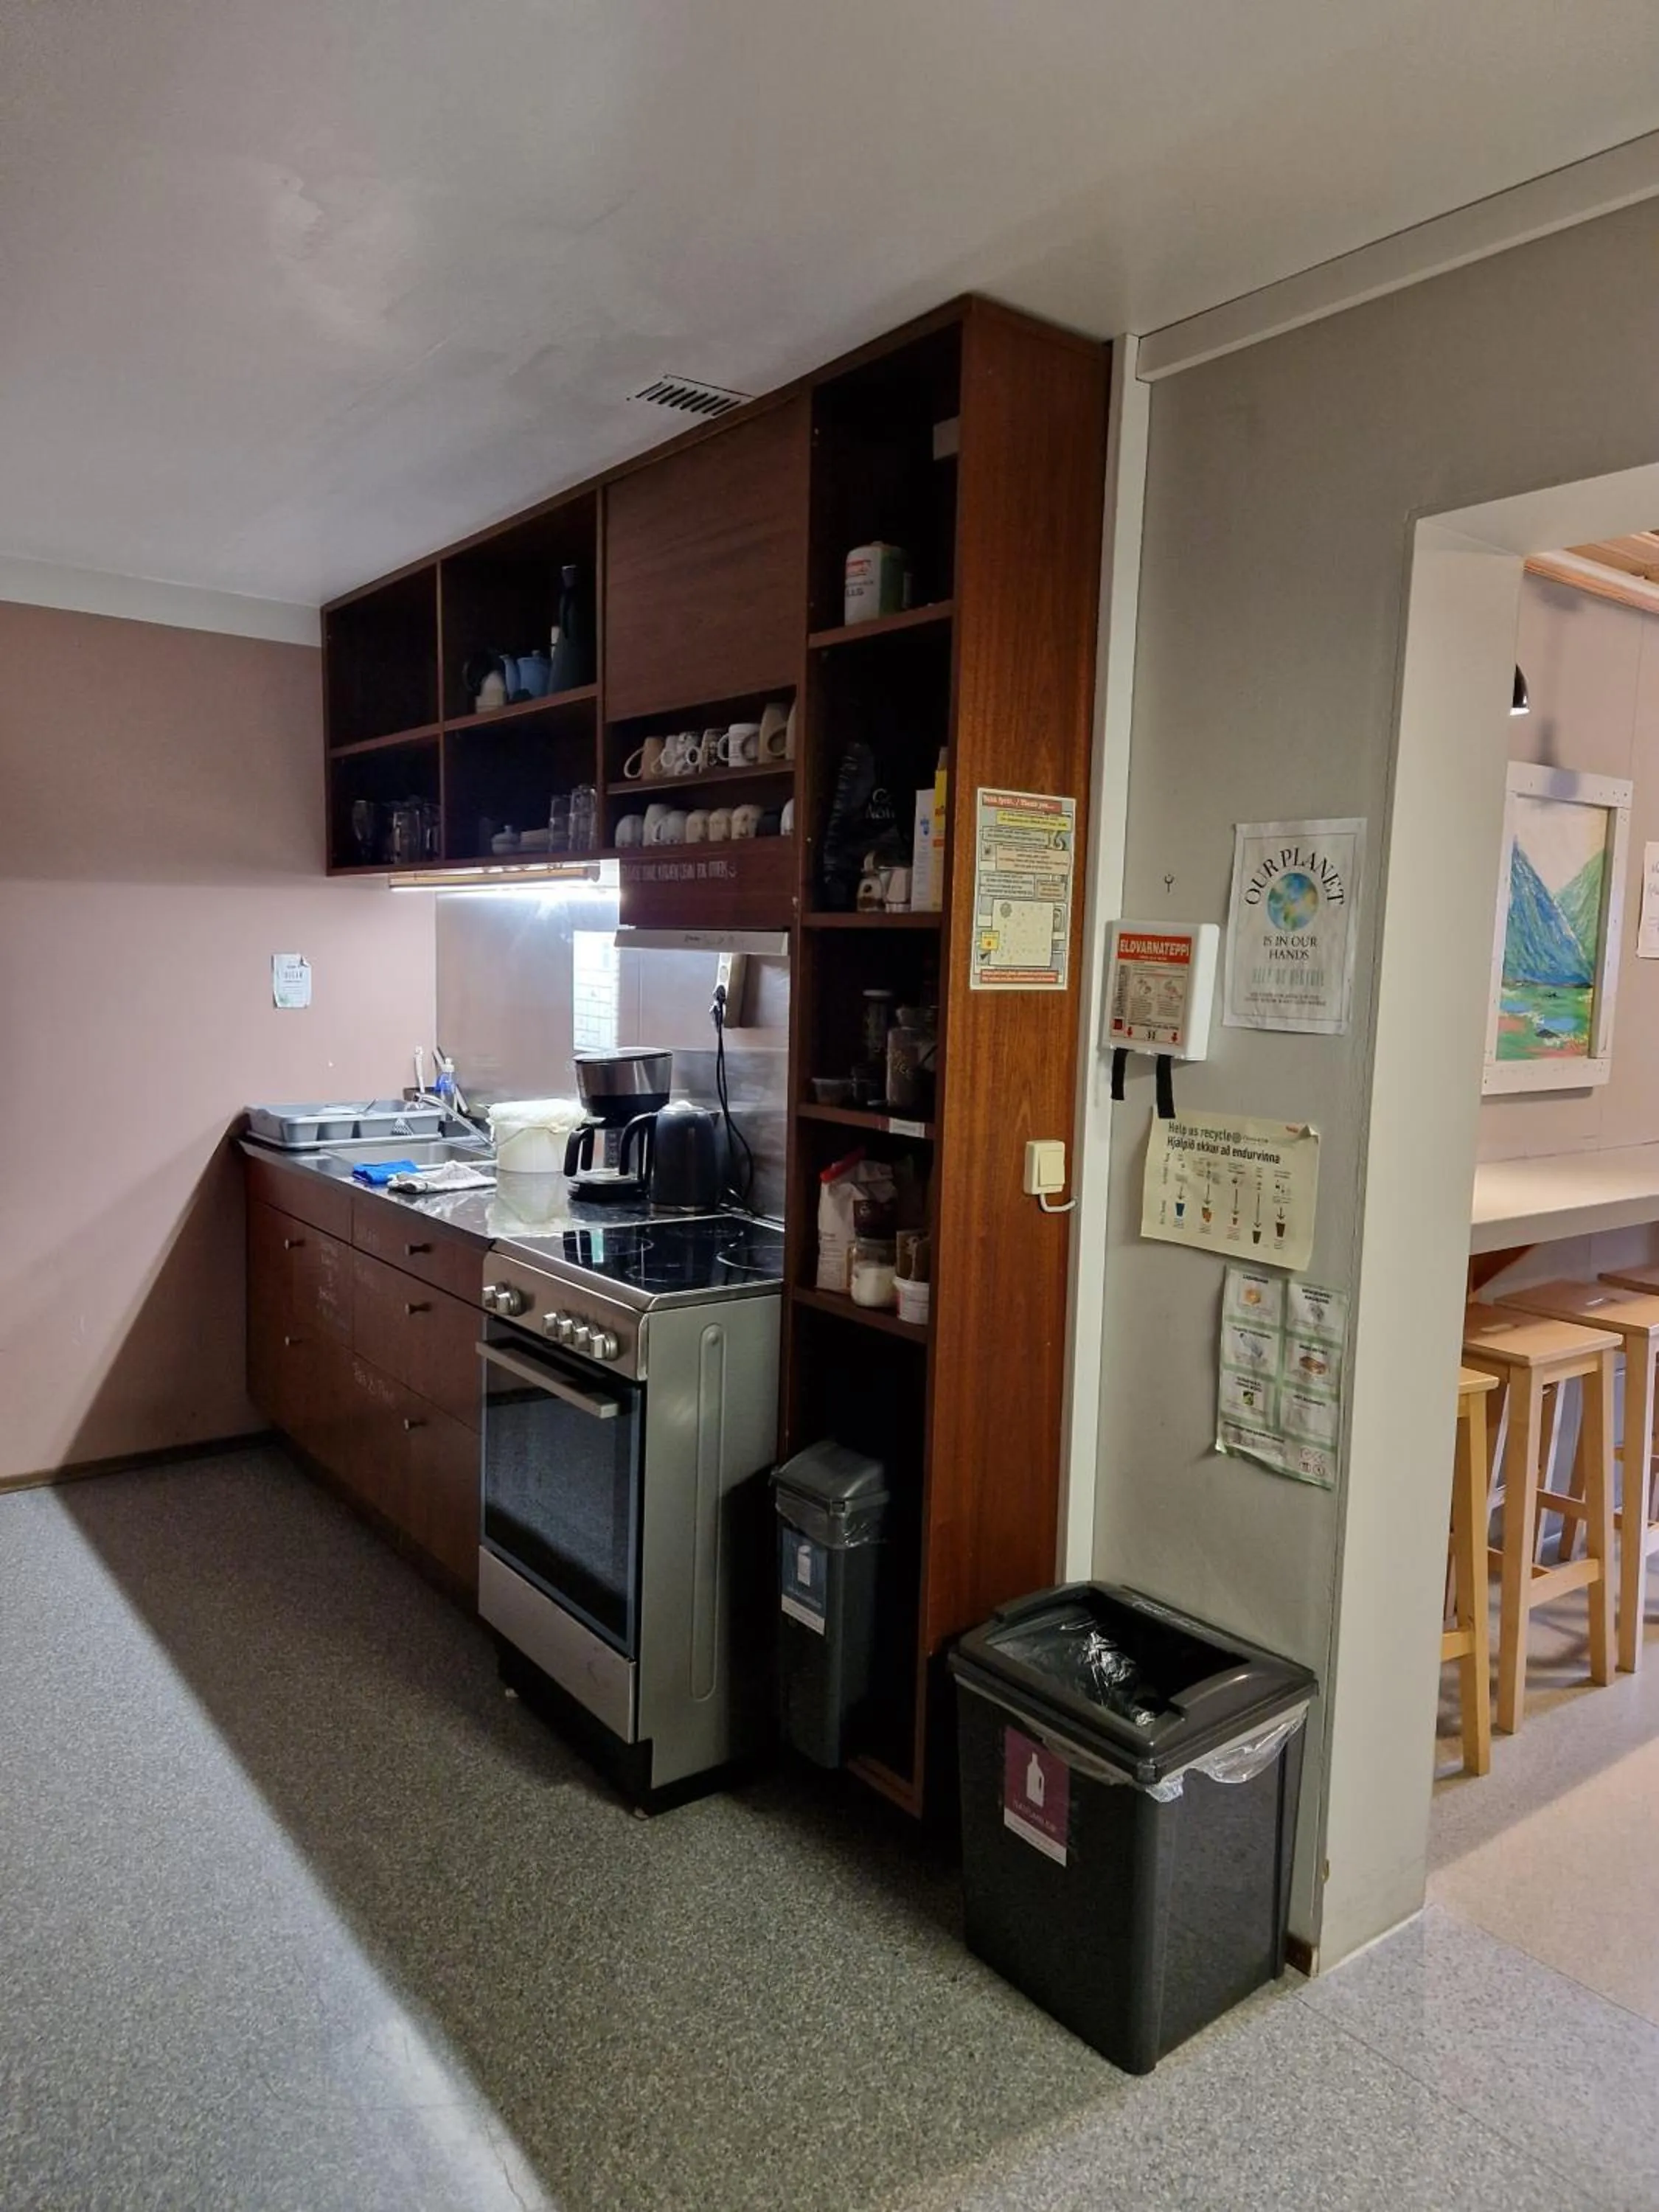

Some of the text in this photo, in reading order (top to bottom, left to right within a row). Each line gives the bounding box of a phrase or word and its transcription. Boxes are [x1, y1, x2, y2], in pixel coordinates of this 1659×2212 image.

[1245, 848, 1345, 905] OUR PLANET
[1119, 939, 1189, 956] ELDVARNATEPPI
[1263, 935, 1318, 947] IS IN OUR
[1269, 949, 1310, 960] HANDS
[1168, 1121, 1186, 1136] Help
[1200, 1128, 1232, 1142] recycle
[1232, 1147, 1281, 1164] endurvinna
